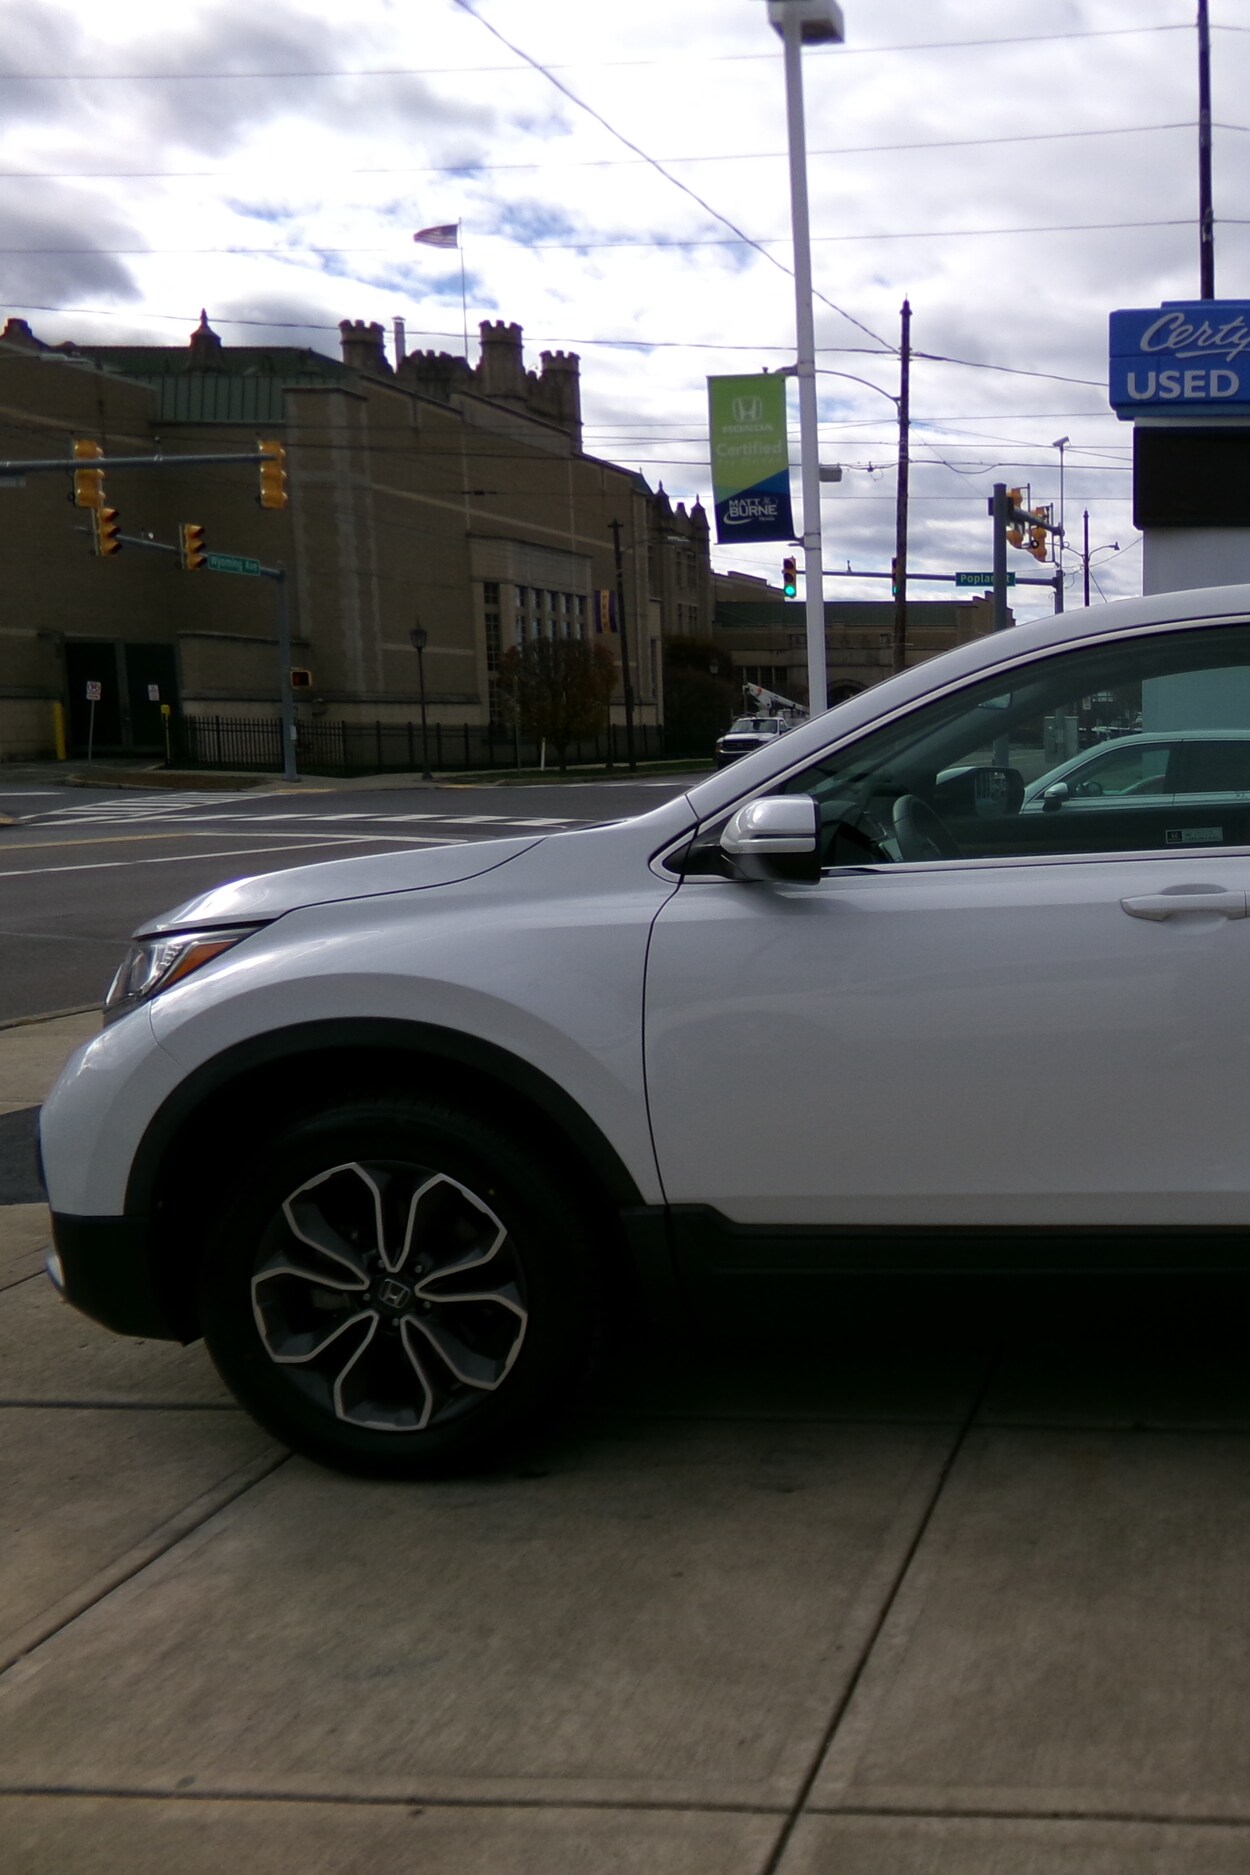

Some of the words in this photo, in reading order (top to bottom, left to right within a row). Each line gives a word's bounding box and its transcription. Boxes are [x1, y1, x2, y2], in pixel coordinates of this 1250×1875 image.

[1127, 369, 1240, 400] USED
[722, 424, 774, 434] HONDA
[716, 440, 782, 457] Certified
[728, 498, 760, 507] MATT
[730, 504, 777, 517] BURNE
